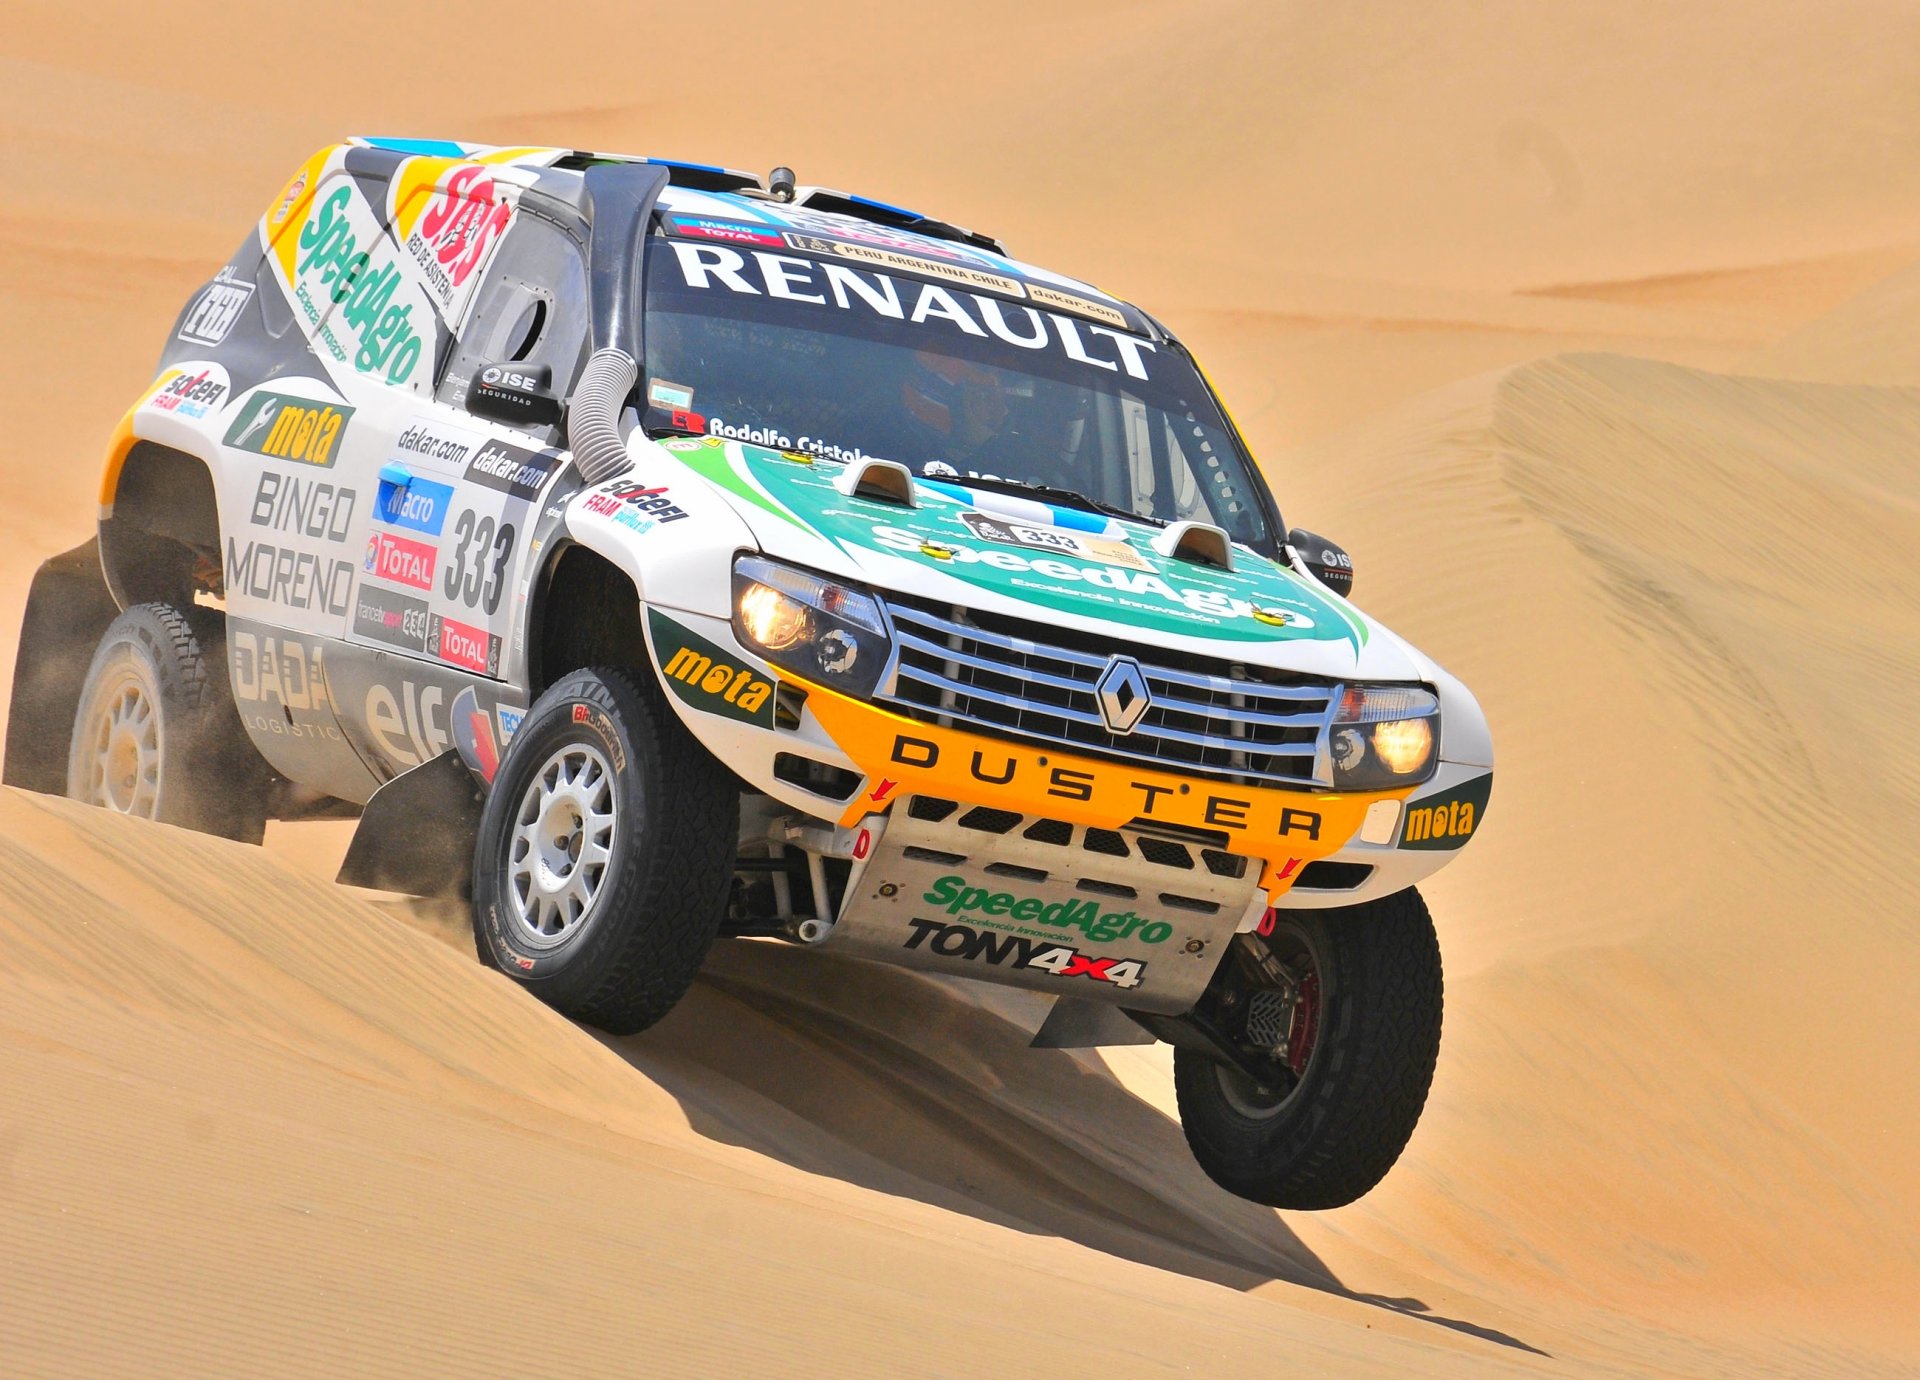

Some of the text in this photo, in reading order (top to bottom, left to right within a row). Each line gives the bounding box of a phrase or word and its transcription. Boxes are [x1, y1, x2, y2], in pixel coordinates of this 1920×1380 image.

[698, 220, 752, 233] Macro
[701, 228, 760, 241] TOTAL
[407, 233, 423, 256] RED
[417, 248, 430, 267] DE
[845, 246, 1013, 290] PERU ARGENTINA CHILE
[298, 185, 422, 385] SpeedAgro
[1033, 288, 1121, 320] dakar.com
[667, 240, 1157, 382] RENAULT
[477, 388, 532, 406] SEGURIDAD
[501, 372, 537, 391] ISE
[261, 406, 342, 464] mota
[398, 425, 469, 463] dakar.com
[709, 417, 792, 449] Rodolfo
[473, 447, 548, 489] dakar.com
[250, 471, 356, 542] BINGO
[387, 485, 434, 522] Macro
[582, 494, 622, 518] FRAM
[1021, 529, 1080, 550] 333
[225, 536, 354, 617] MORENO
[382, 539, 432, 584] TOTAL
[444, 508, 515, 616] 333
[871, 525, 1315, 629] SpeedAgro
[444, 625, 485, 663] TOTAL
[235, 632, 341, 714] DADA
[663, 646, 772, 713] mota
[246, 715, 343, 741] LOGISTIC
[365, 681, 451, 765] elf
[891, 734, 1322, 841] DUSTER
[1406, 800, 1474, 842] mota
[923, 876, 1173, 943] SpeedAgro
[957, 915, 1015, 933] Excelencia
